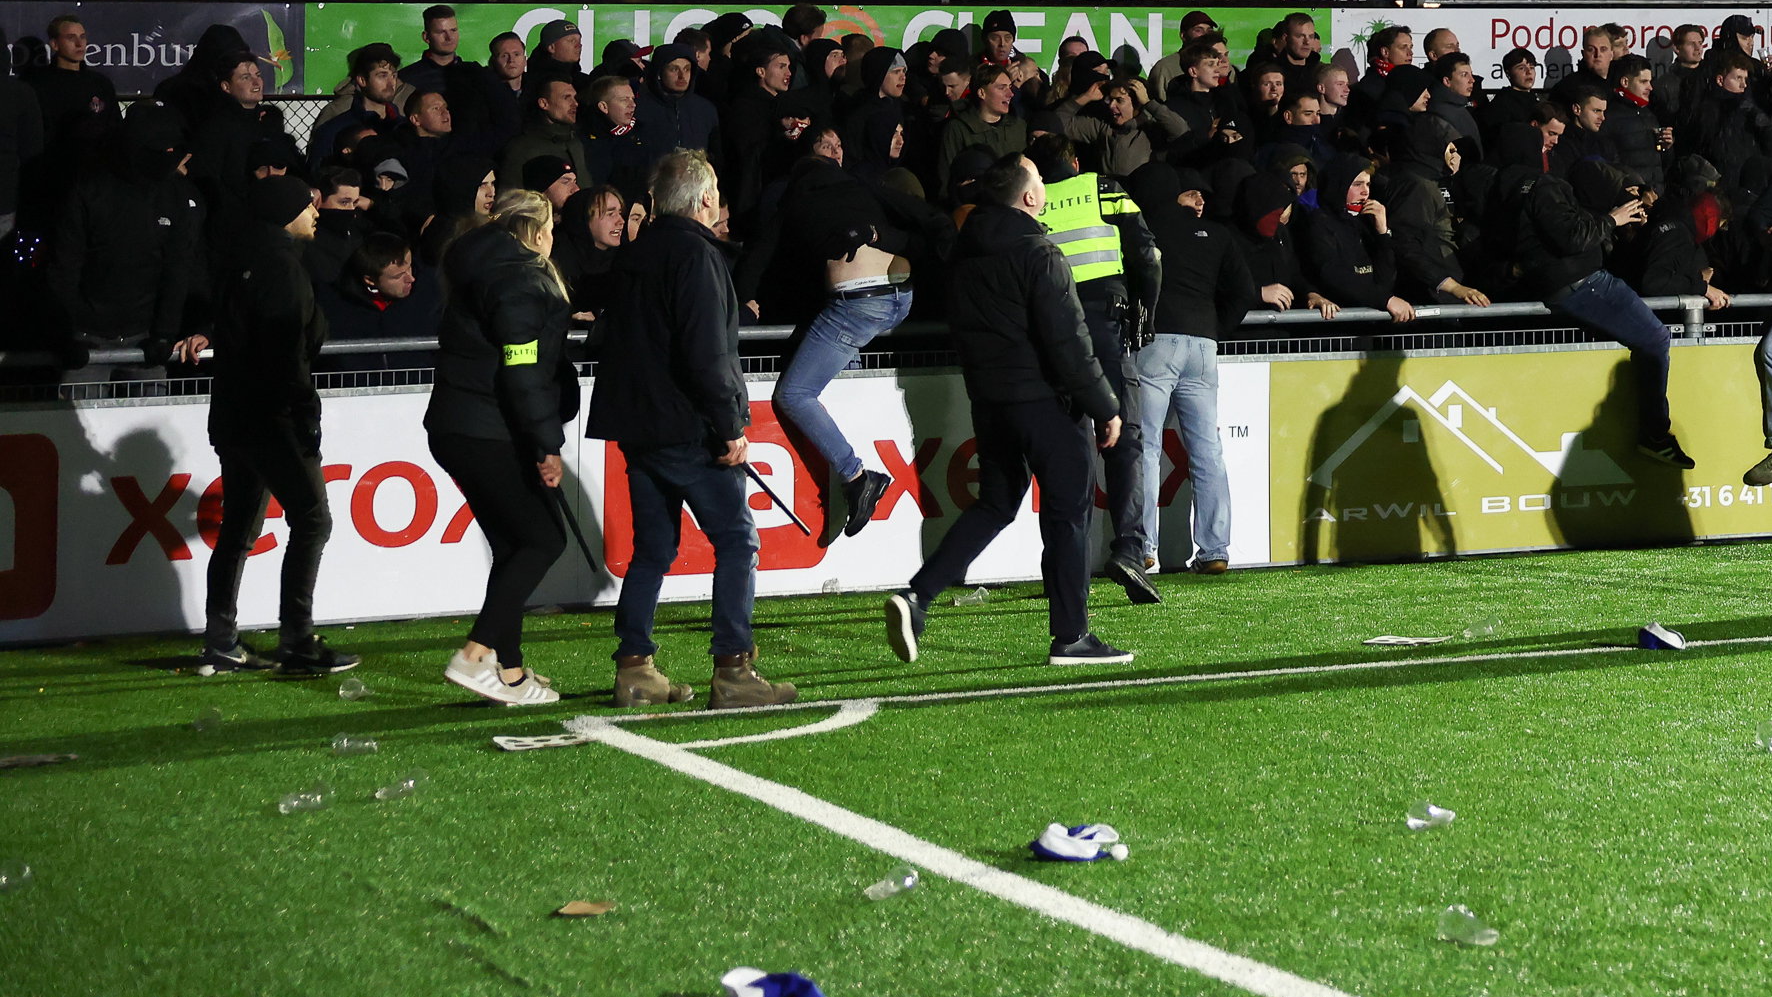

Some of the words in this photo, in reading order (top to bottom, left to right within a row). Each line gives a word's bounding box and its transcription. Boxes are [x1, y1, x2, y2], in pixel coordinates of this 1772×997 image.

[1039, 194, 1092, 217] LITIE
[1228, 425, 1249, 438] TM
[1303, 501, 1457, 523] ARWIL
[1481, 489, 1637, 514] BOUW
[1718, 484, 1734, 507] 6
[1738, 484, 1764, 505] 41
